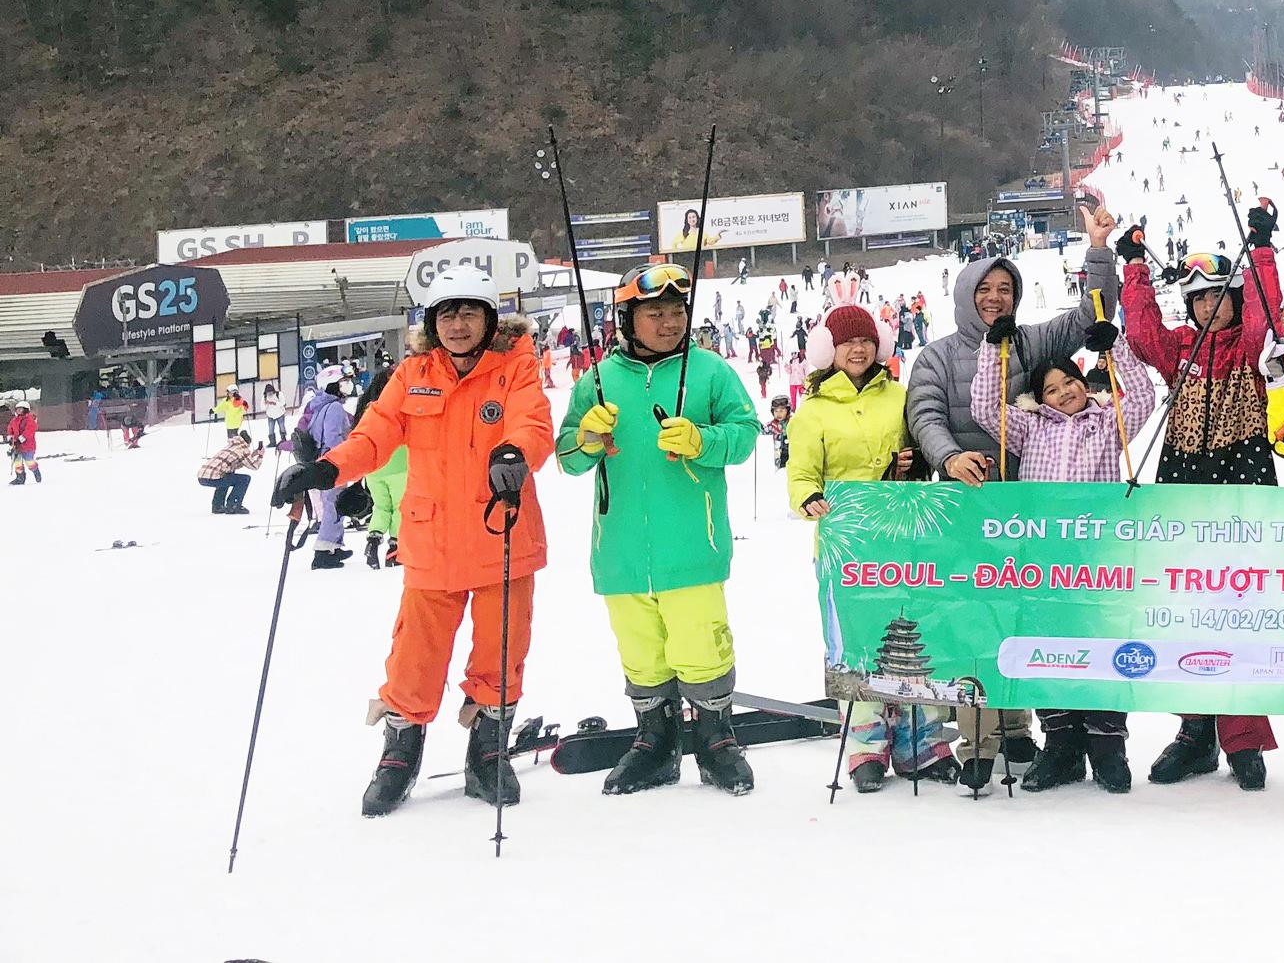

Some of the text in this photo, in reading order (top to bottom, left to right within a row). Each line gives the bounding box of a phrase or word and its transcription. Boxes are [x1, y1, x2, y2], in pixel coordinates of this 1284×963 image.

[889, 201, 918, 211] XIAN
[465, 221, 483, 230] am
[465, 227, 493, 236] your
[177, 237, 217, 260] GS
[112, 277, 198, 322] GS25
[158, 323, 190, 336] Platform
[982, 513, 1046, 539] ĐÓN
[1056, 512, 1107, 539] TẾT
[1115, 515, 1185, 541] GIÁP
[1192, 516, 1262, 543] THÌN
[841, 562, 944, 587] SEOUL
[974, 557, 1043, 588] ĐẢO
[1050, 565, 1135, 591] NAMI
[1164, 566, 1271, 598] TRƯỢT
[1145, 606, 1171, 627] 10
